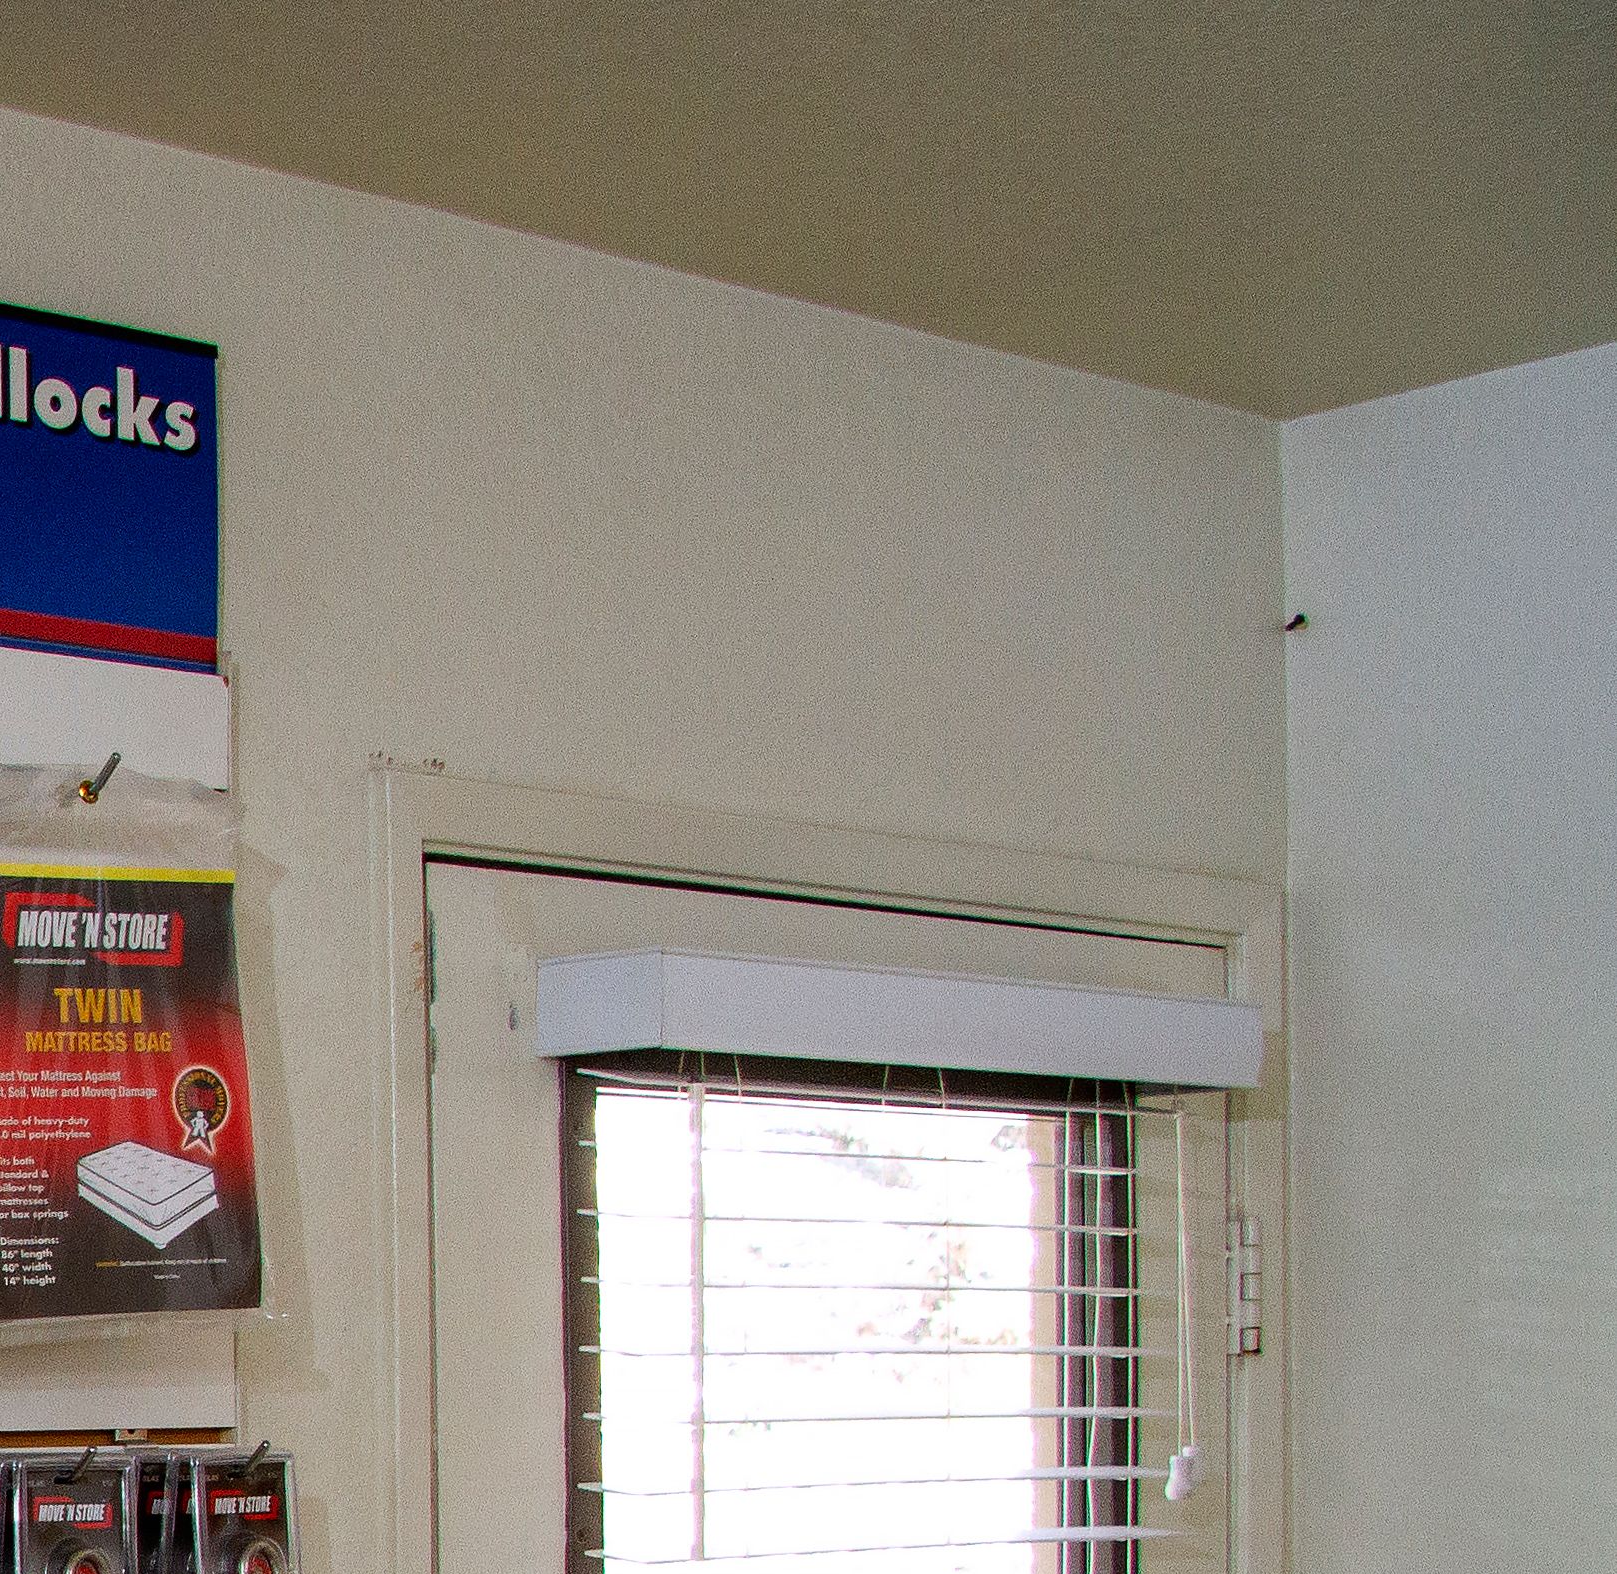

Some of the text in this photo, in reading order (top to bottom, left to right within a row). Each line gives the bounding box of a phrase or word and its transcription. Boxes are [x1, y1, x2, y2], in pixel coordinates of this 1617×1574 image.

[18, 911, 77, 948] MOVE
[102, 913, 168, 950] STORE
[54, 988, 142, 1024] TWIN
[25, 1031, 172, 1053] MATTRESS BAG
